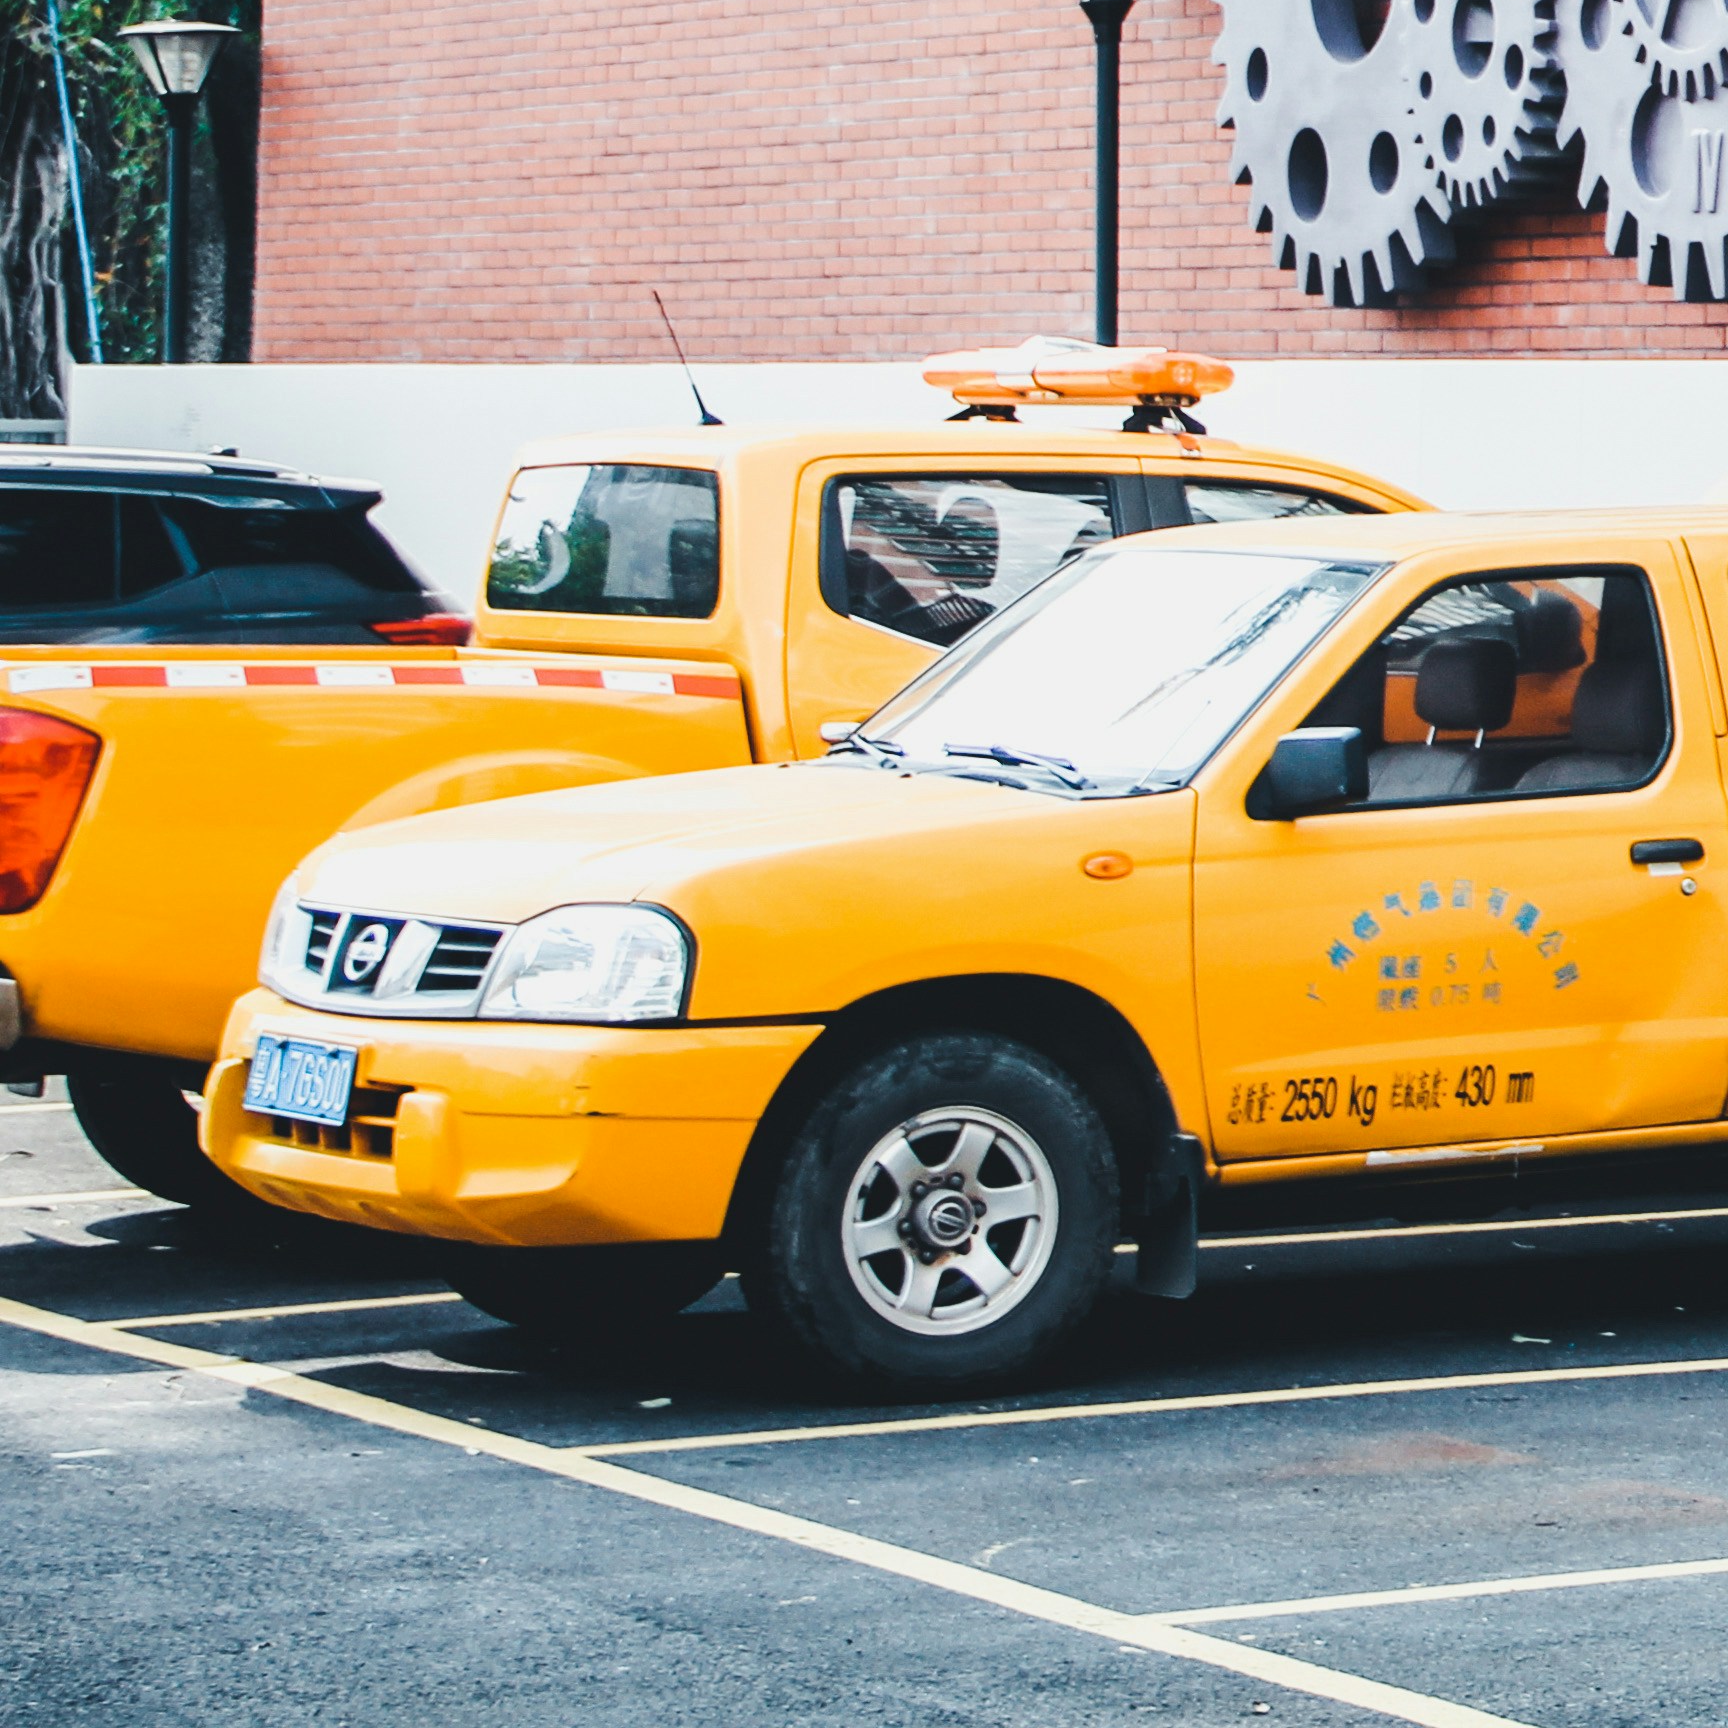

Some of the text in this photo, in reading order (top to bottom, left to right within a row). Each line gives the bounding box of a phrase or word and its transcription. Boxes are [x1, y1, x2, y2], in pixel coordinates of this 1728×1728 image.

[1280, 1077, 1338, 1122] 2550
[1348, 1075, 1378, 1127] kg
[1455, 1064, 1496, 1108] 430
